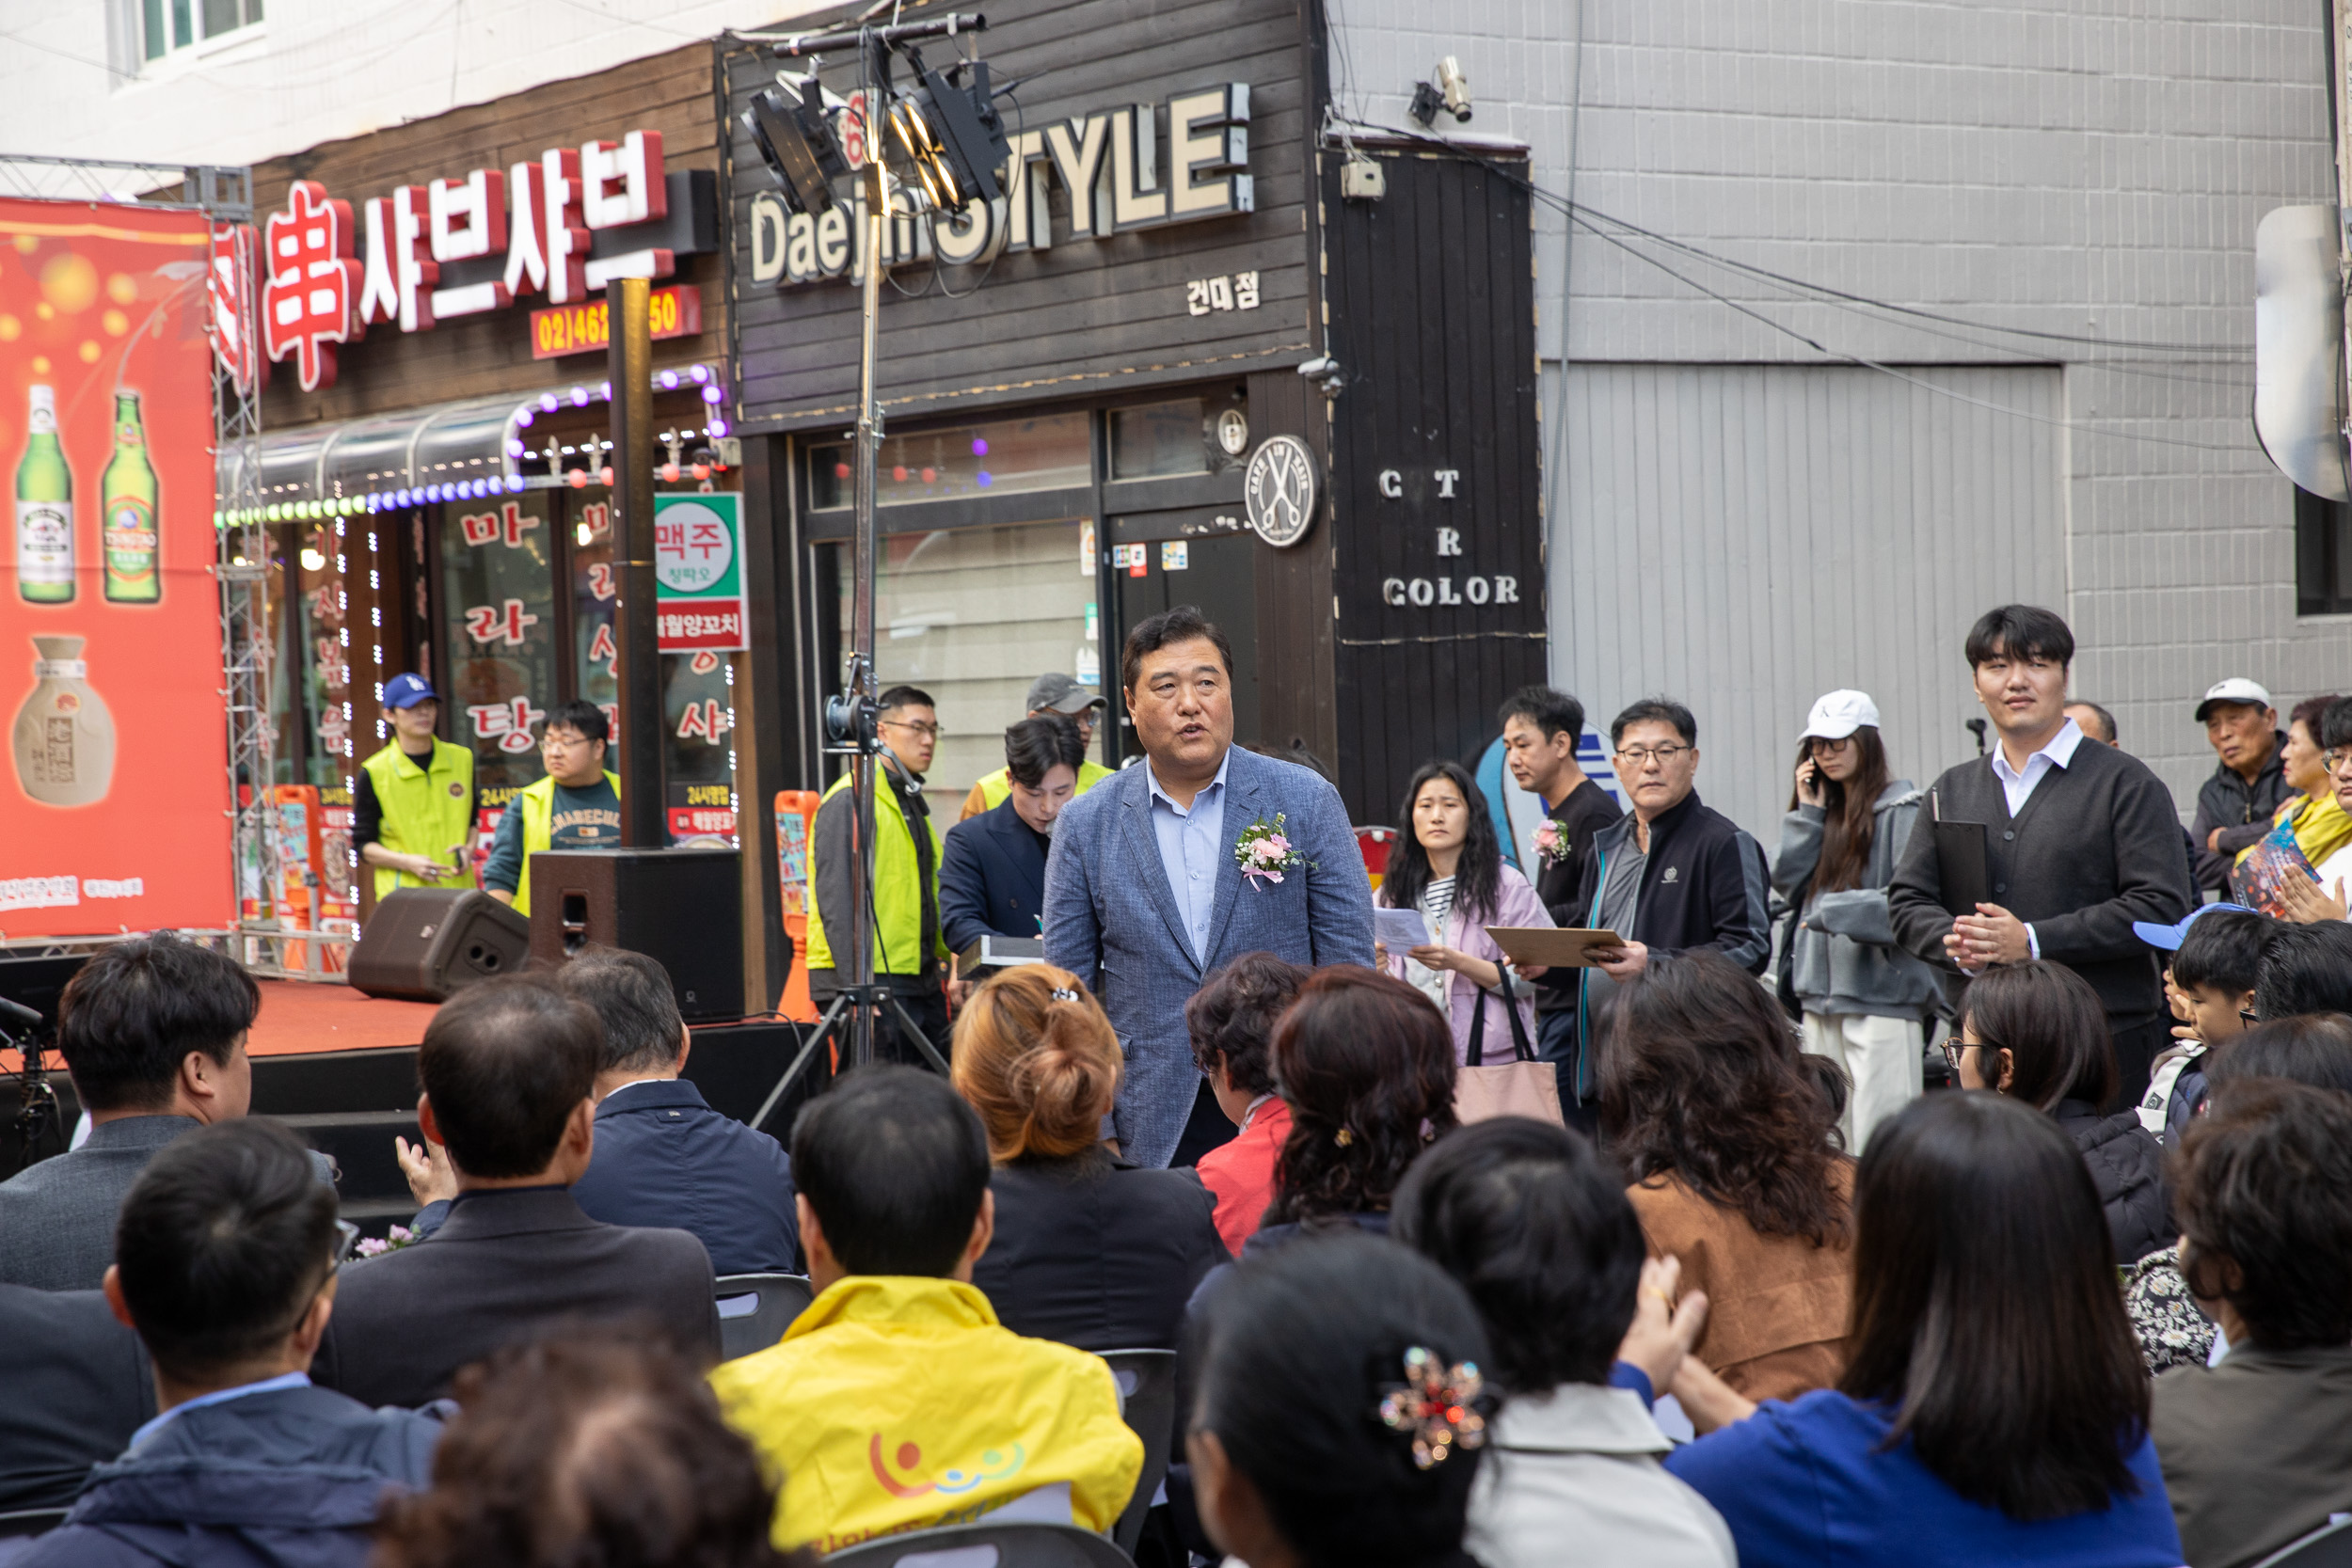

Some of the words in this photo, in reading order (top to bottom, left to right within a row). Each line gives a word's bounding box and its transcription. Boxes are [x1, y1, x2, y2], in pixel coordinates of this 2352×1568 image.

[751, 177, 924, 287] Daejn
[654, 523, 723, 562] 맥주
[1436, 526, 1463, 556] R
[1382, 575, 1519, 607] COLOR
